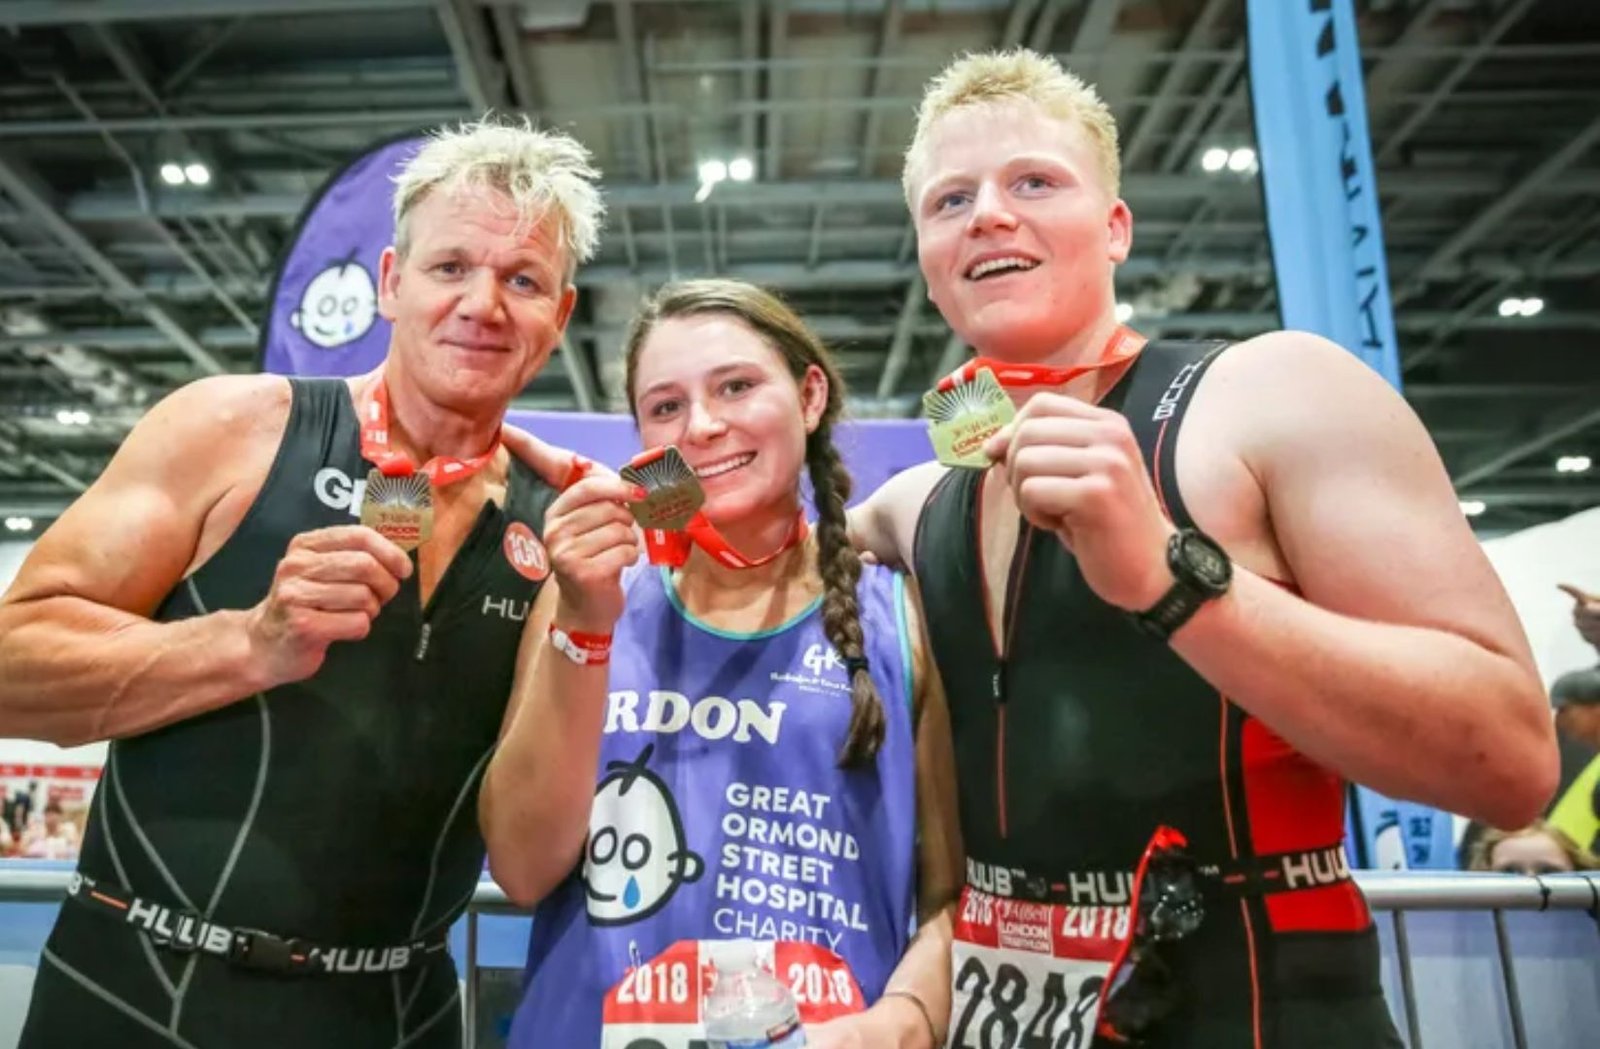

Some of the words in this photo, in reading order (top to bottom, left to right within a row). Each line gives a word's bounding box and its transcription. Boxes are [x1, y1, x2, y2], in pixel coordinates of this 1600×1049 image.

[603, 690, 787, 744] RDON
[726, 782, 831, 819] GREAT
[722, 813, 860, 861] ORMOND
[721, 843, 833, 886] STREET
[716, 873, 869, 931] HOSPITAL
[1062, 906, 1131, 940] 2018
[713, 907, 844, 953] CHARITY
[1001, 922, 1048, 940] LONDON
[617, 962, 688, 1005] 2018
